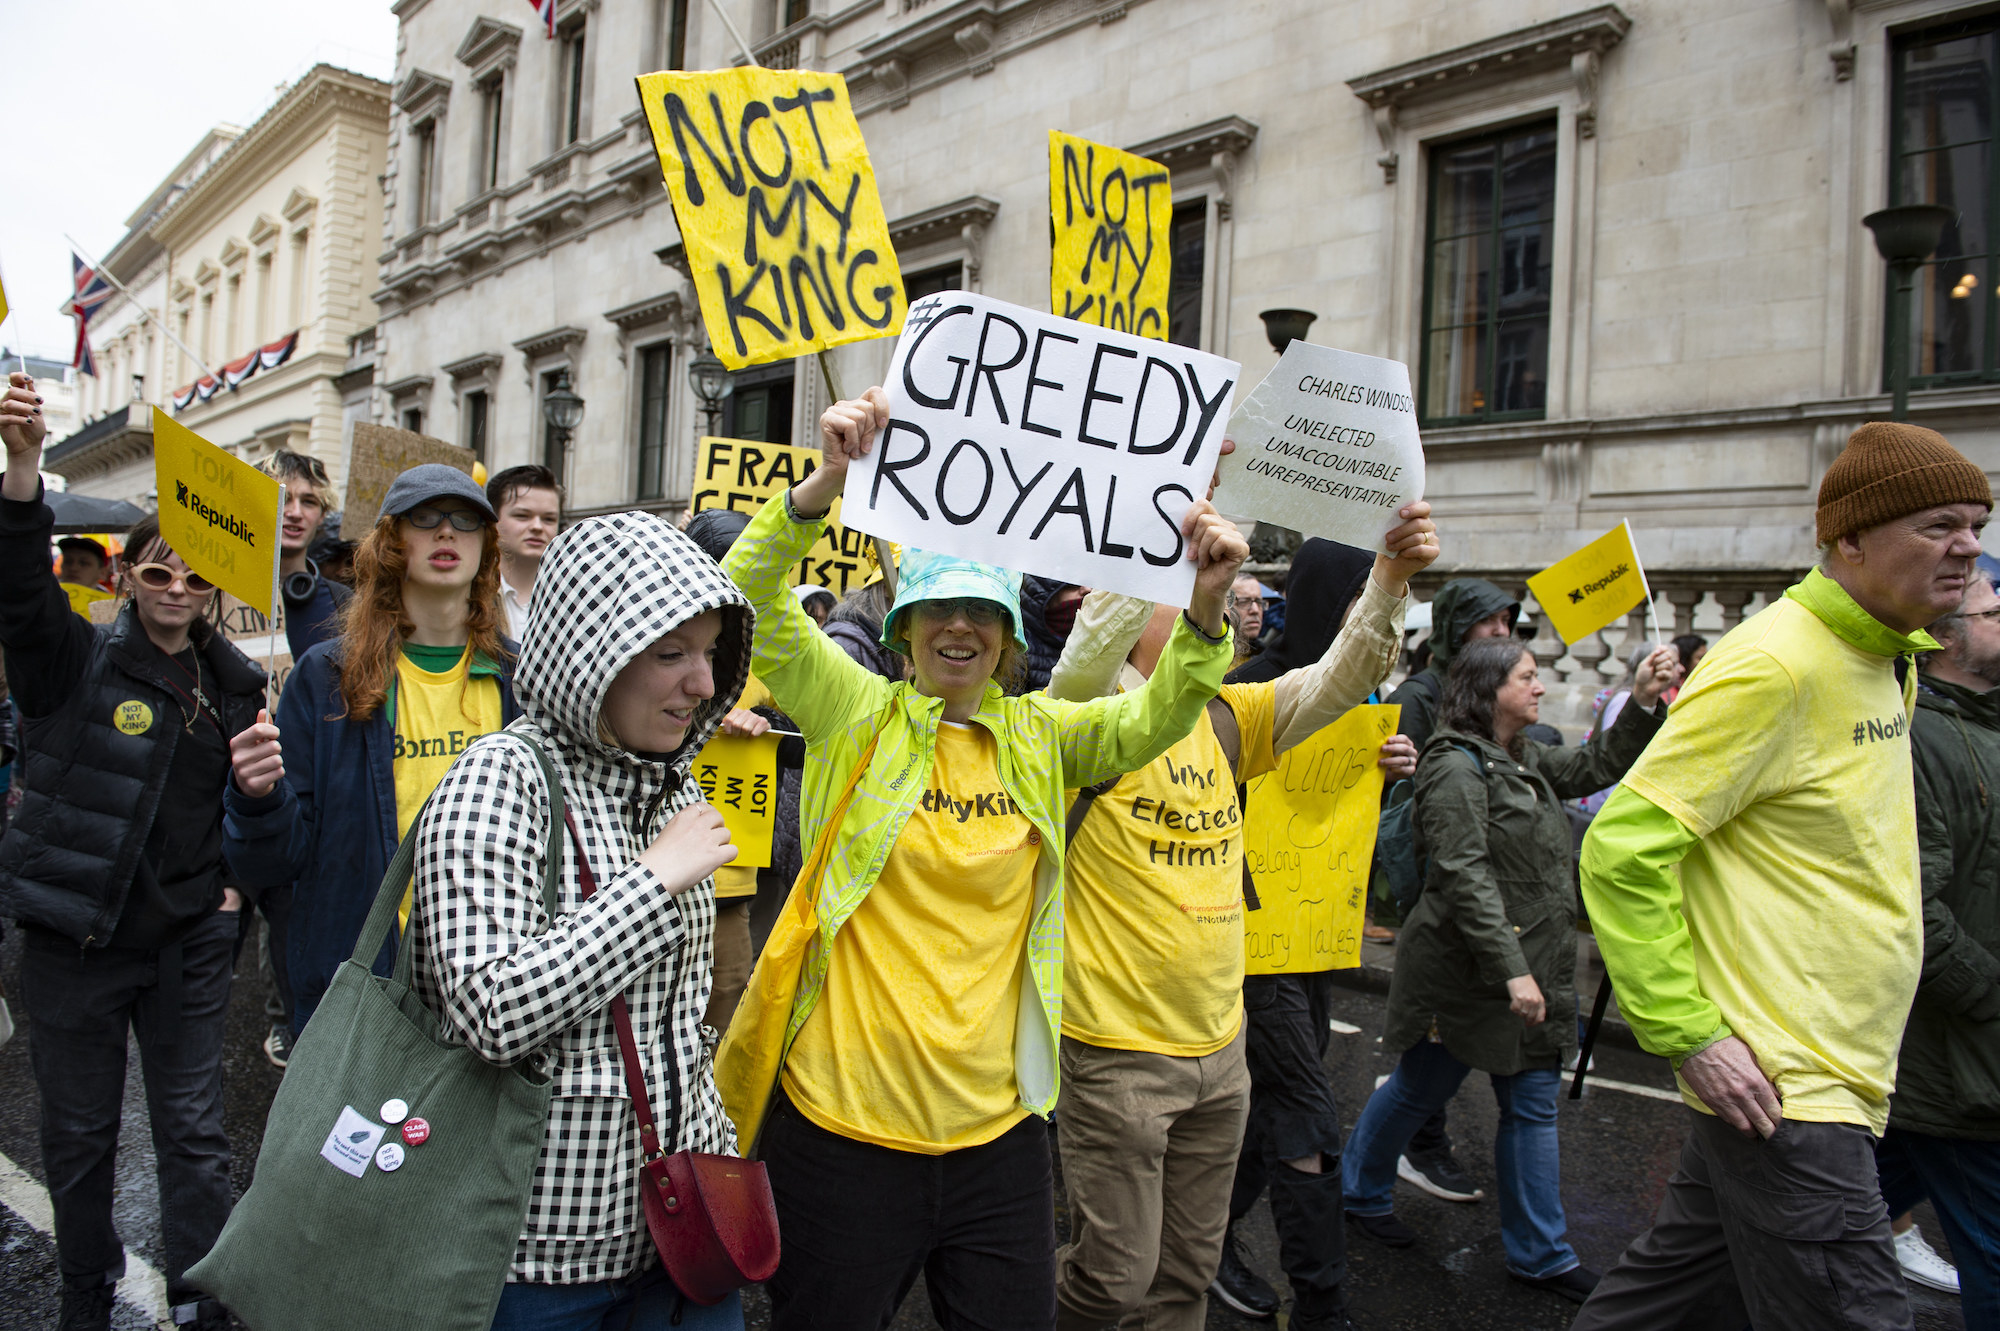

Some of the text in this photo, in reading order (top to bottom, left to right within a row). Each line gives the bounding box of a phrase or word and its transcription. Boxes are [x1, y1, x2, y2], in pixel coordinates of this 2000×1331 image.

[664, 87, 835, 206] NOT
[1063, 144, 1168, 235] NOT
[744, 172, 860, 266] MY
[1081, 224, 1154, 301] MY
[716, 244, 895, 357] KING
[902, 296, 1233, 466] #GREEDY
[1298, 375, 1365, 404] CHARLES
[1284, 414, 1375, 448] UNELECTED
[1265, 436, 1402, 482] UNACCOUNTABLE
[869, 418, 1194, 567] ROYALS
[1246, 458, 1400, 508] UNREPRESENTATIVE
[190, 493, 255, 548] Republic
[1583, 562, 1630, 596] Republic
[122, 721, 147, 731] KING
[123, 704, 142, 713] NOT
[126, 713, 141, 721] MY
[725, 776, 743, 809] MY
[750, 773, 768, 817] NOT
[1131, 795, 1238, 833] Elected
[1150, 839, 1228, 867] Him?
[1246, 826, 1354, 892] belong in
[1298, 897, 1356, 959] Tales
[405, 1123, 426, 1132] CLASS
[407, 1131, 424, 1139] WAR
[382, 1147, 392, 1155] not
[384, 1160, 399, 1169] king
